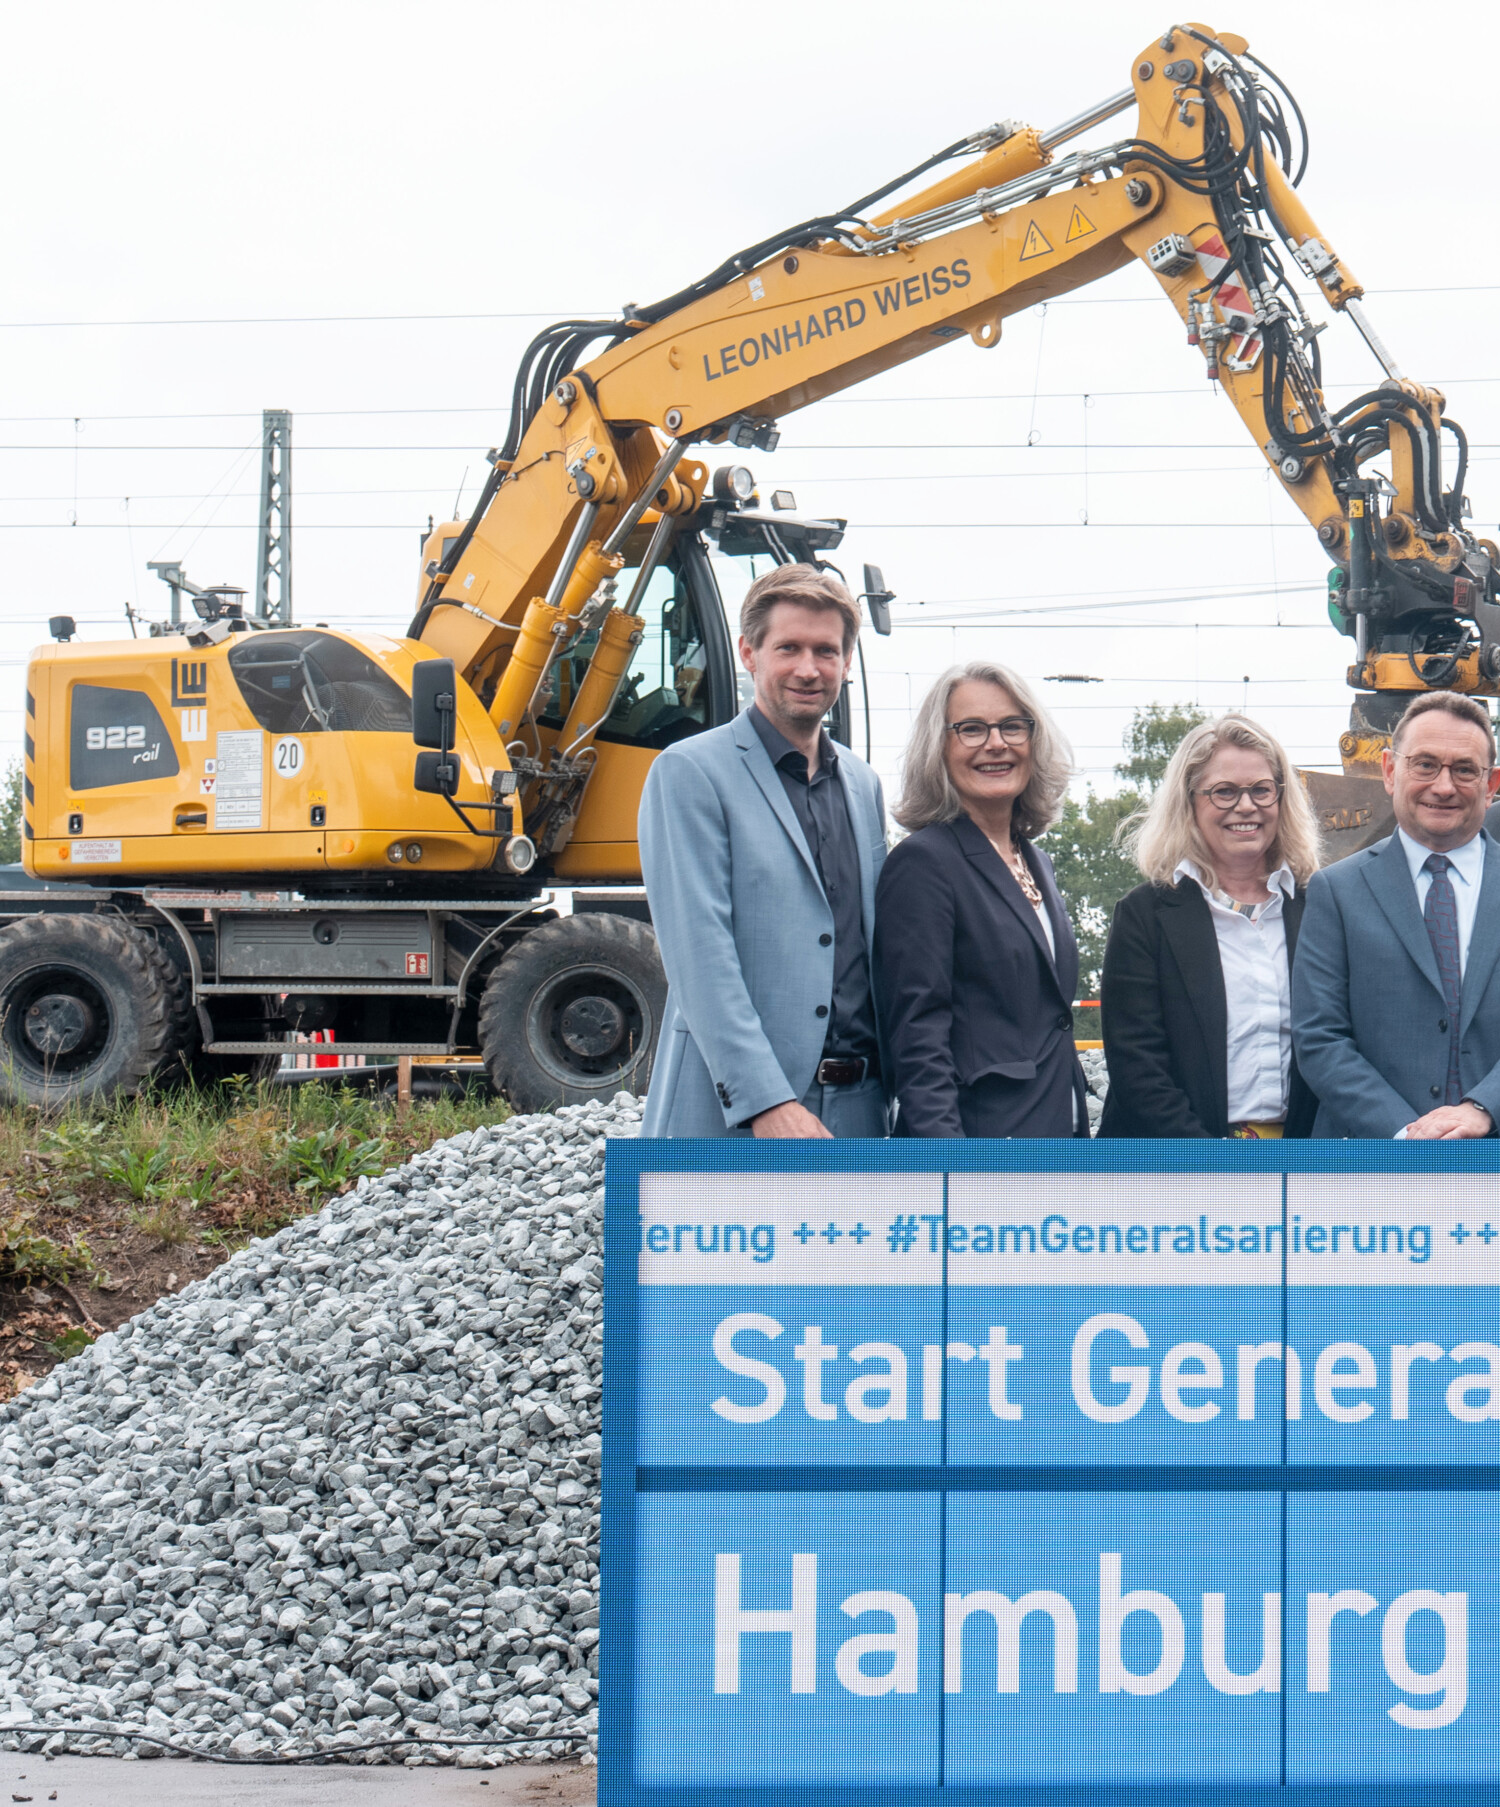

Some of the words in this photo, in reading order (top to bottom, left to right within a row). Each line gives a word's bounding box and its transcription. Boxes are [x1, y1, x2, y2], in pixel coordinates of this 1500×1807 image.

[703, 297, 867, 382] LEONHARD
[873, 258, 972, 317] WEISS
[86, 725, 146, 750] 922
[132, 742, 160, 764] rail
[278, 743, 298, 769] 20
[886, 1213, 1432, 1264] #TeamGeneralsanierung
[709, 1311, 1024, 1424] Start
[712, 1550, 1471, 1730] Hamburg
